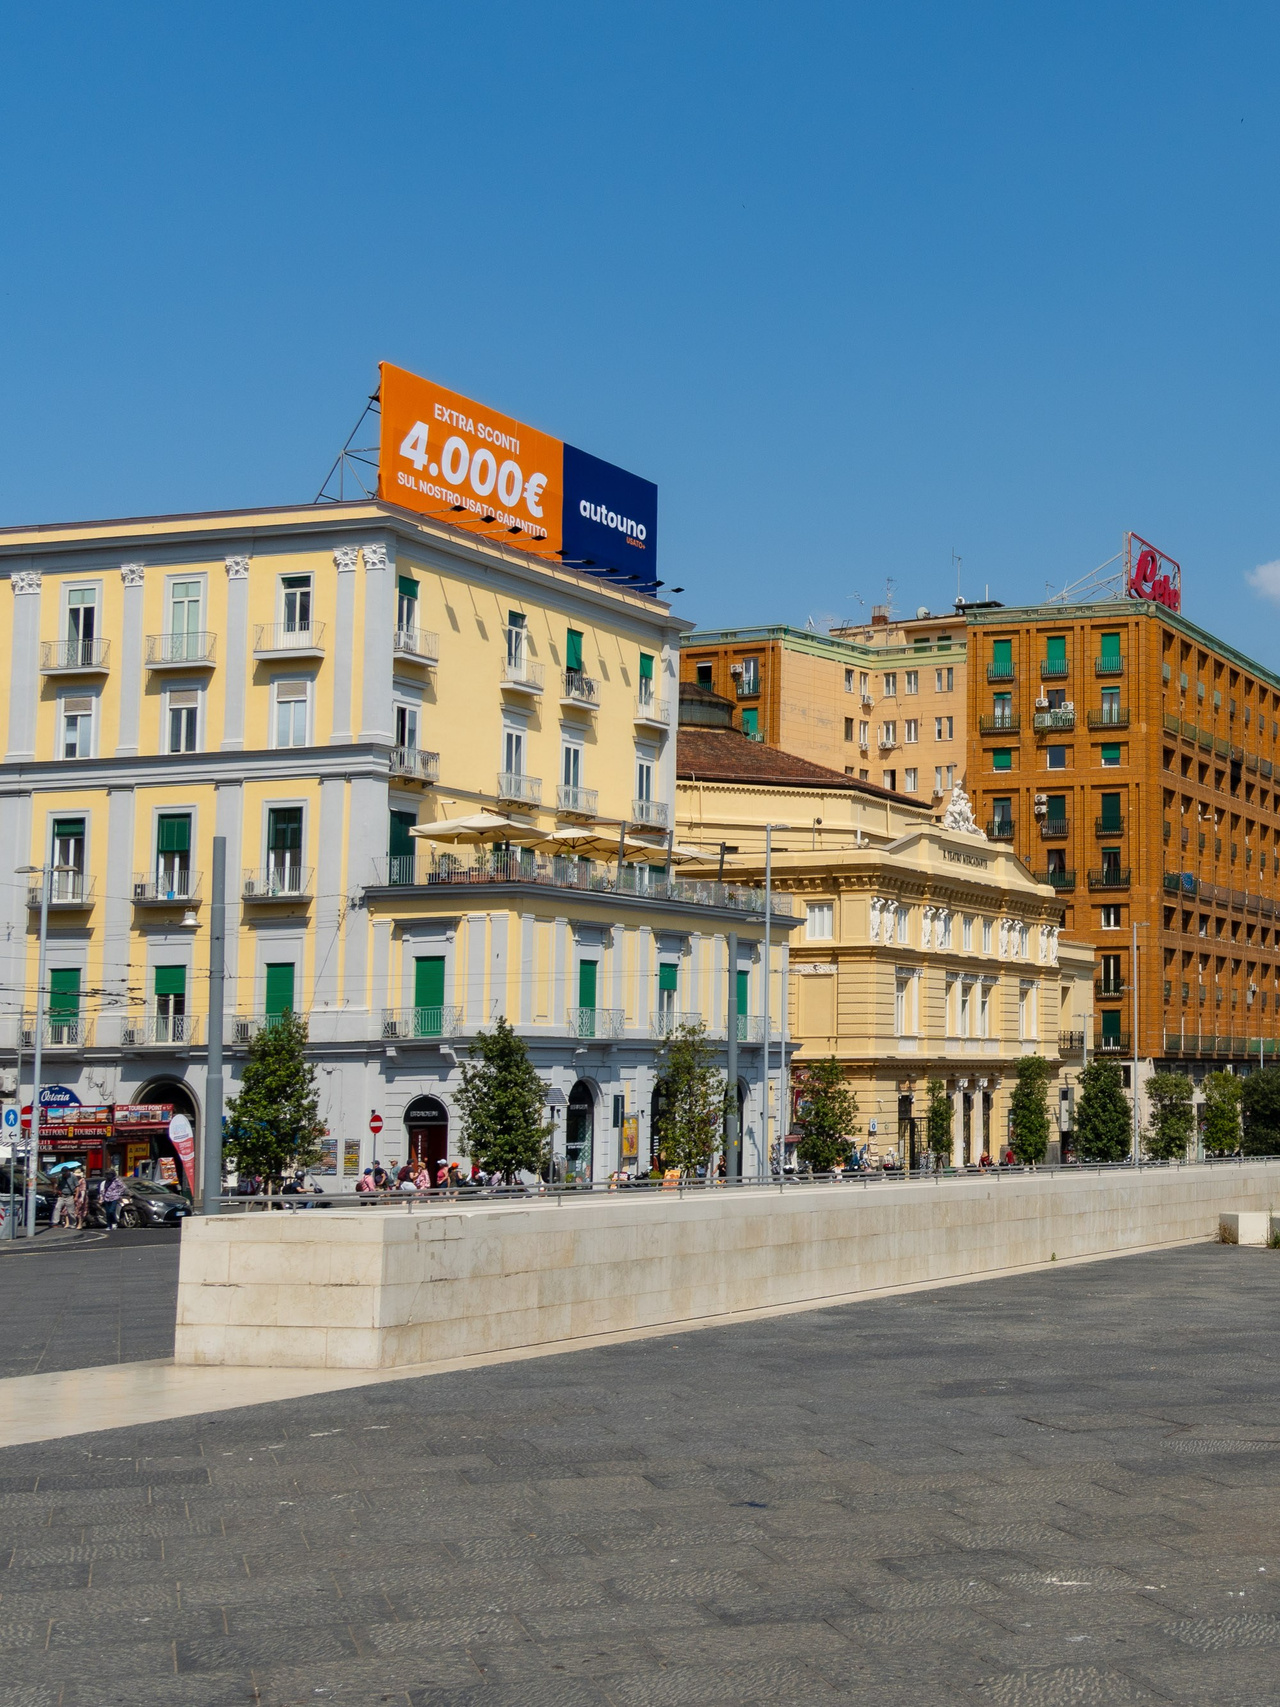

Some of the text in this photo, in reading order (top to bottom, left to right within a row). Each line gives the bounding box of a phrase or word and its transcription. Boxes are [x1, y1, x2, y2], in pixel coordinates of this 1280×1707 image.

[434, 403, 520, 455] EXTRA SCONTI
[399, 420, 548, 518] 4.000€
[397, 471, 548, 538] SUL NOSTRO USATO GARANTITO
[580, 499, 647, 541] autouno
[41, 1090, 71, 1102] Osteria
[38, 1128, 51, 1136] CKET
[52, 1128, 68, 1136] POINT
[74, 1128, 96, 1136] TOURIST
